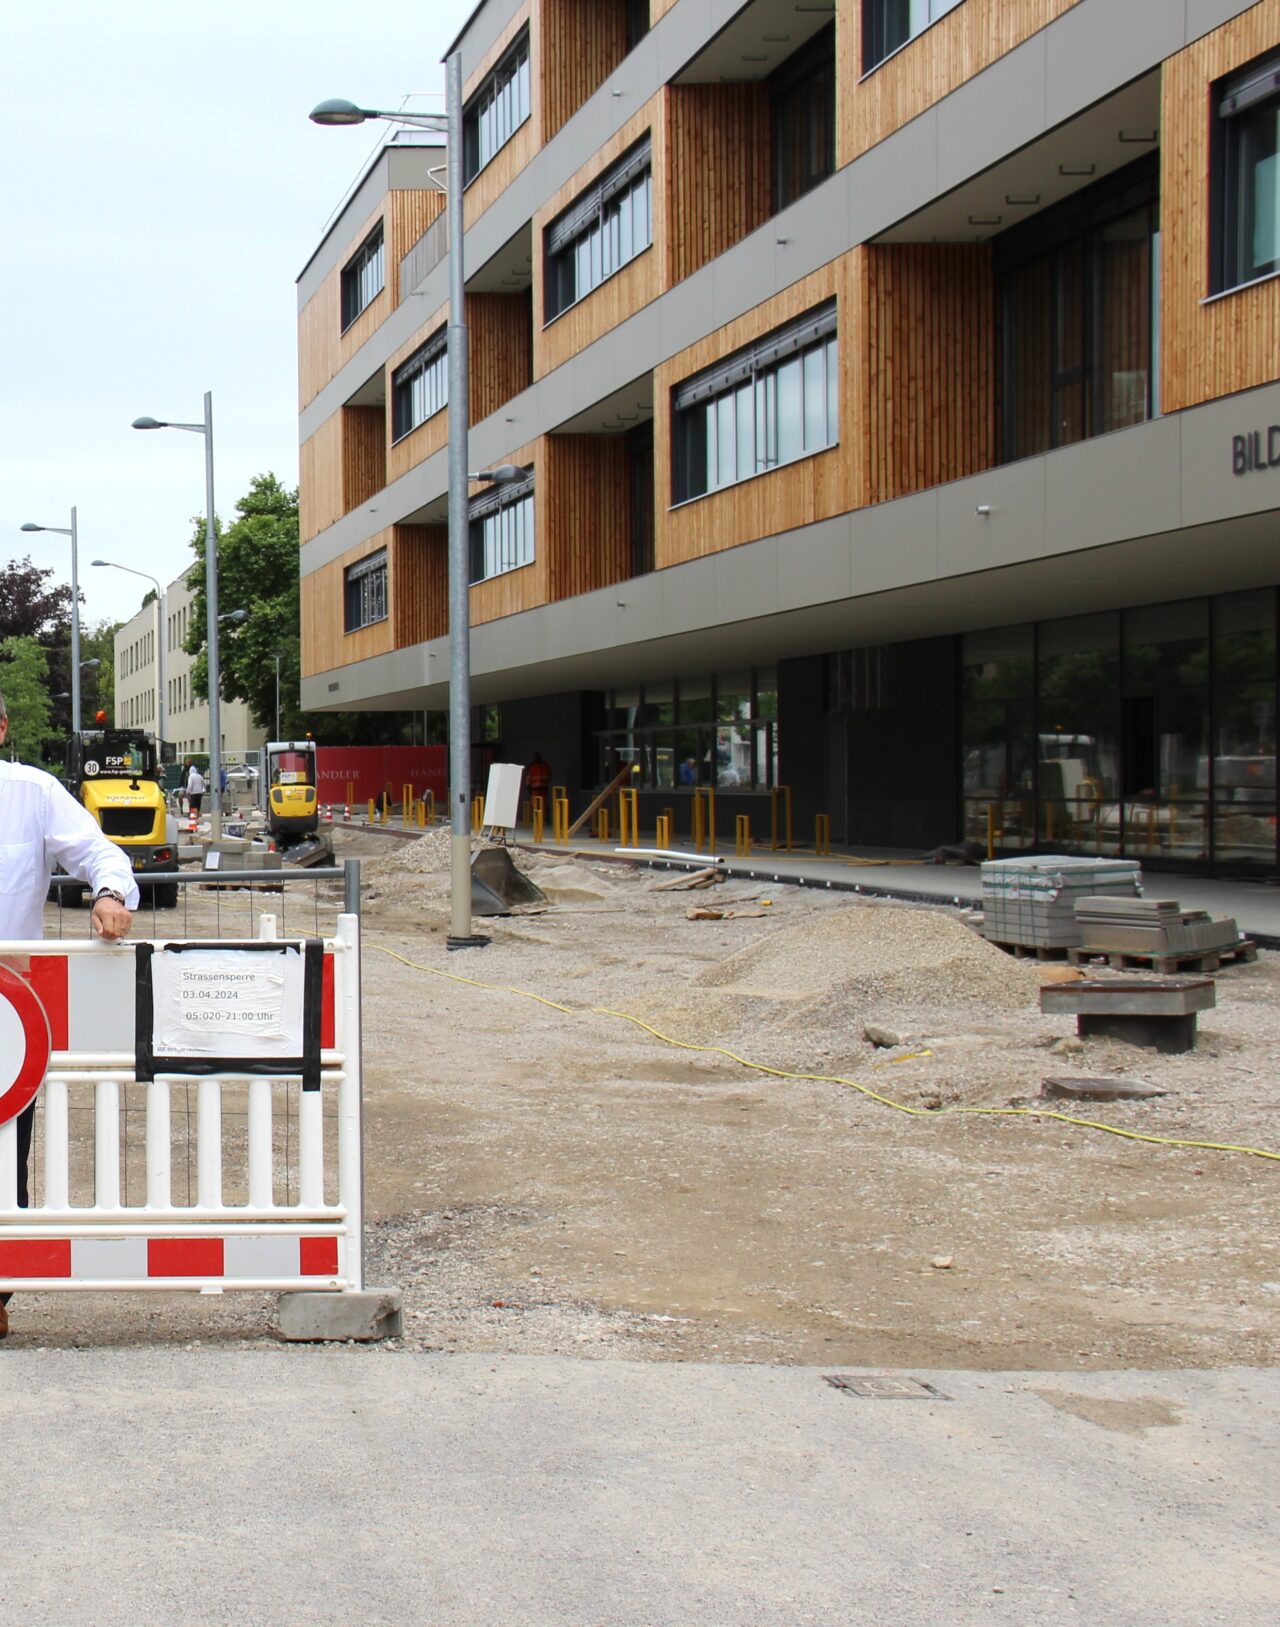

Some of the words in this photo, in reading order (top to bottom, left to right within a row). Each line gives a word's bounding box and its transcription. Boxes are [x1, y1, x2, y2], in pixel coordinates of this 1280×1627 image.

[1232, 425, 1280, 476] BILD
[106, 756, 124, 765] FSP
[86, 763, 97, 773] 30
[183, 972, 256, 982] Strassensperre
[182, 990, 238, 999] 03.04.2024
[185, 1011, 254, 1020] 05:020-21:00
[257, 1012, 274, 1020] Uhr
